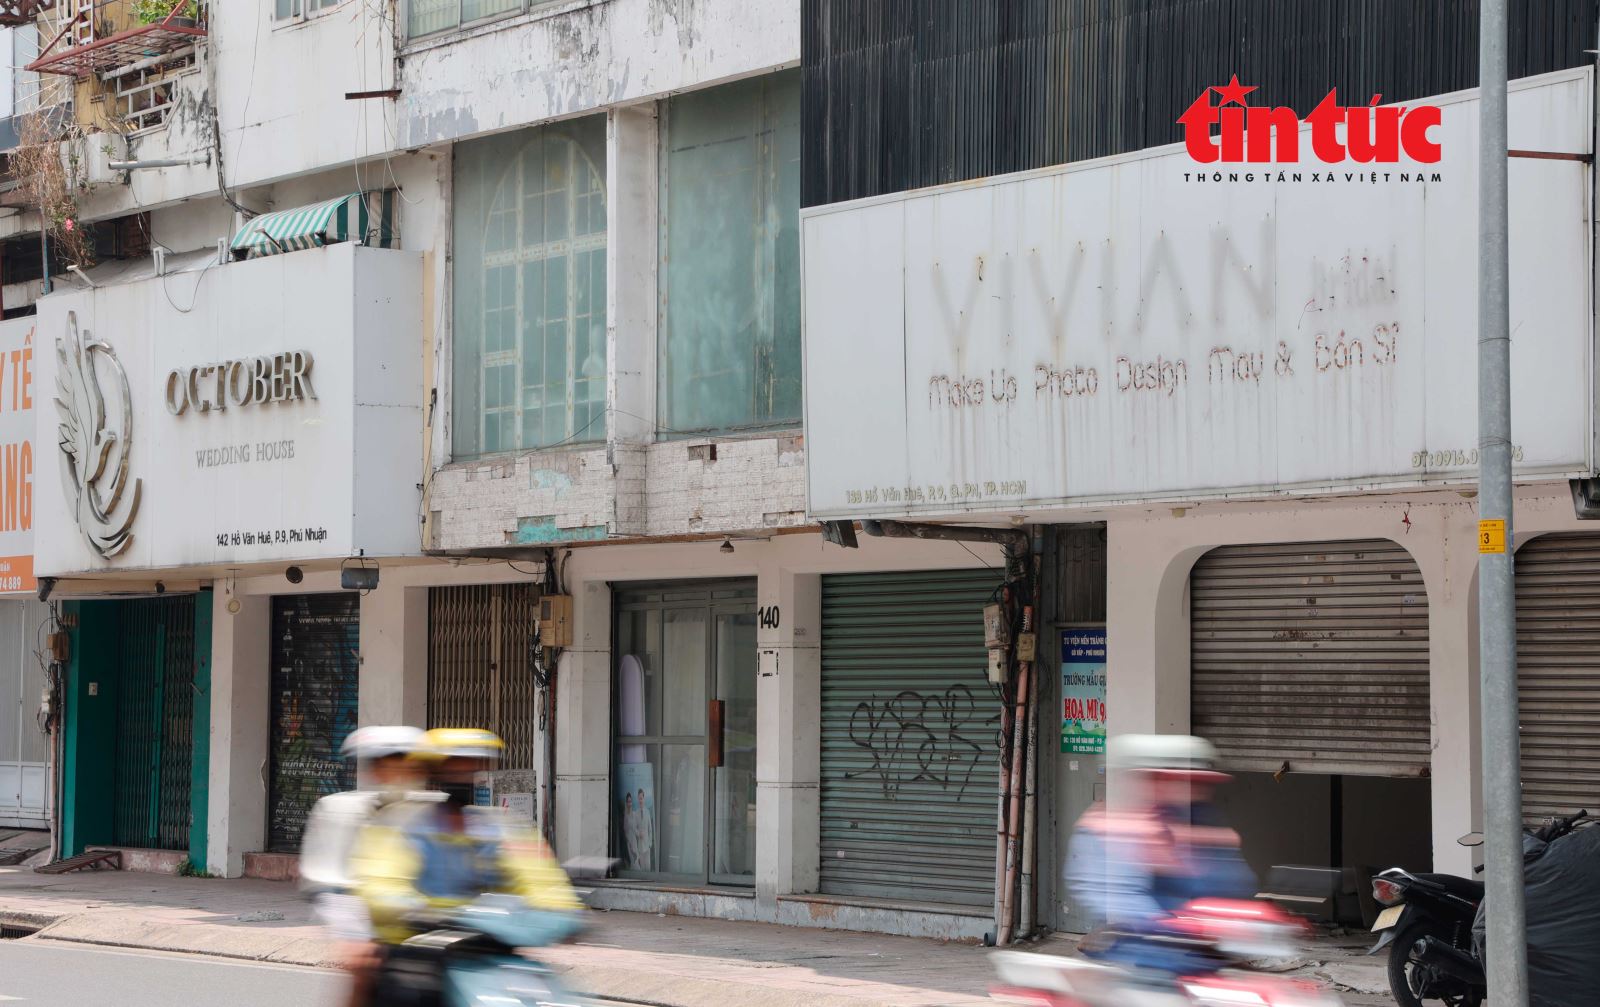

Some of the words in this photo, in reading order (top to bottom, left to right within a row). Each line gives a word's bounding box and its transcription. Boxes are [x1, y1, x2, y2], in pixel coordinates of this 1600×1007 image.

[929, 214, 1275, 350] VIVIAN
[11, 326, 35, 411] TẾ
[991, 368, 1016, 408] Up
[1035, 364, 1098, 400] Photo
[1117, 355, 1188, 396] Design
[1274, 341, 1294, 377] &
[165, 350, 318, 416] OCTOBER
[196, 444, 250, 469] WEDDING
[256, 440, 295, 462] HOUSE
[882, 486, 901, 502] Văn
[1001, 479, 1027, 496] HCM
[216, 533, 229, 547] 142
[231, 530, 241, 546] Hồ
[243, 532, 255, 545] Văn
[305, 526, 327, 543] Nhuận
[9, 575, 22, 590] 889
[758, 606, 780, 629] 140
[1064, 698, 1085, 724] HỌA
